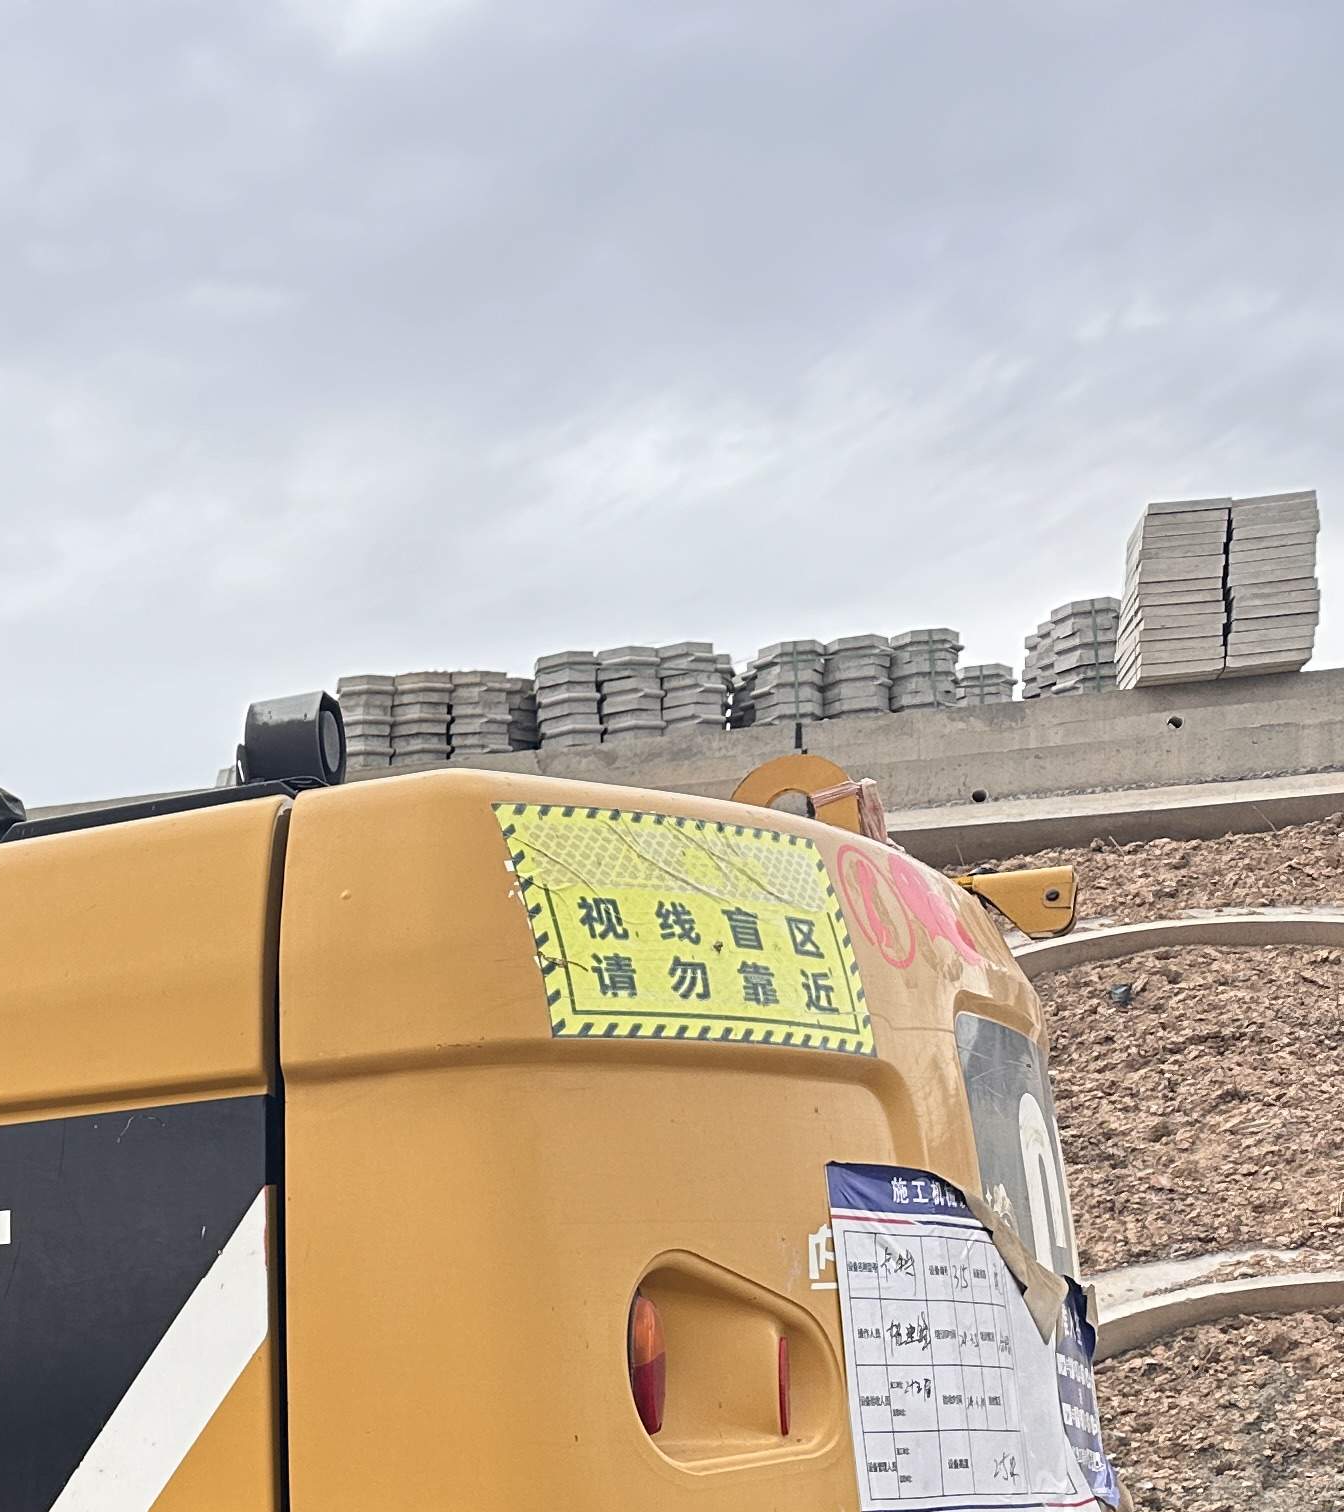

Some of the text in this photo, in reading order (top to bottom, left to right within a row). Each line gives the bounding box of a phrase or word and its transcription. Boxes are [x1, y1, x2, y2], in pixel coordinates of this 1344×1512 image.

[576, 895, 825, 959] 视线盲区
[590, 953, 840, 1015] 请勿靠近
